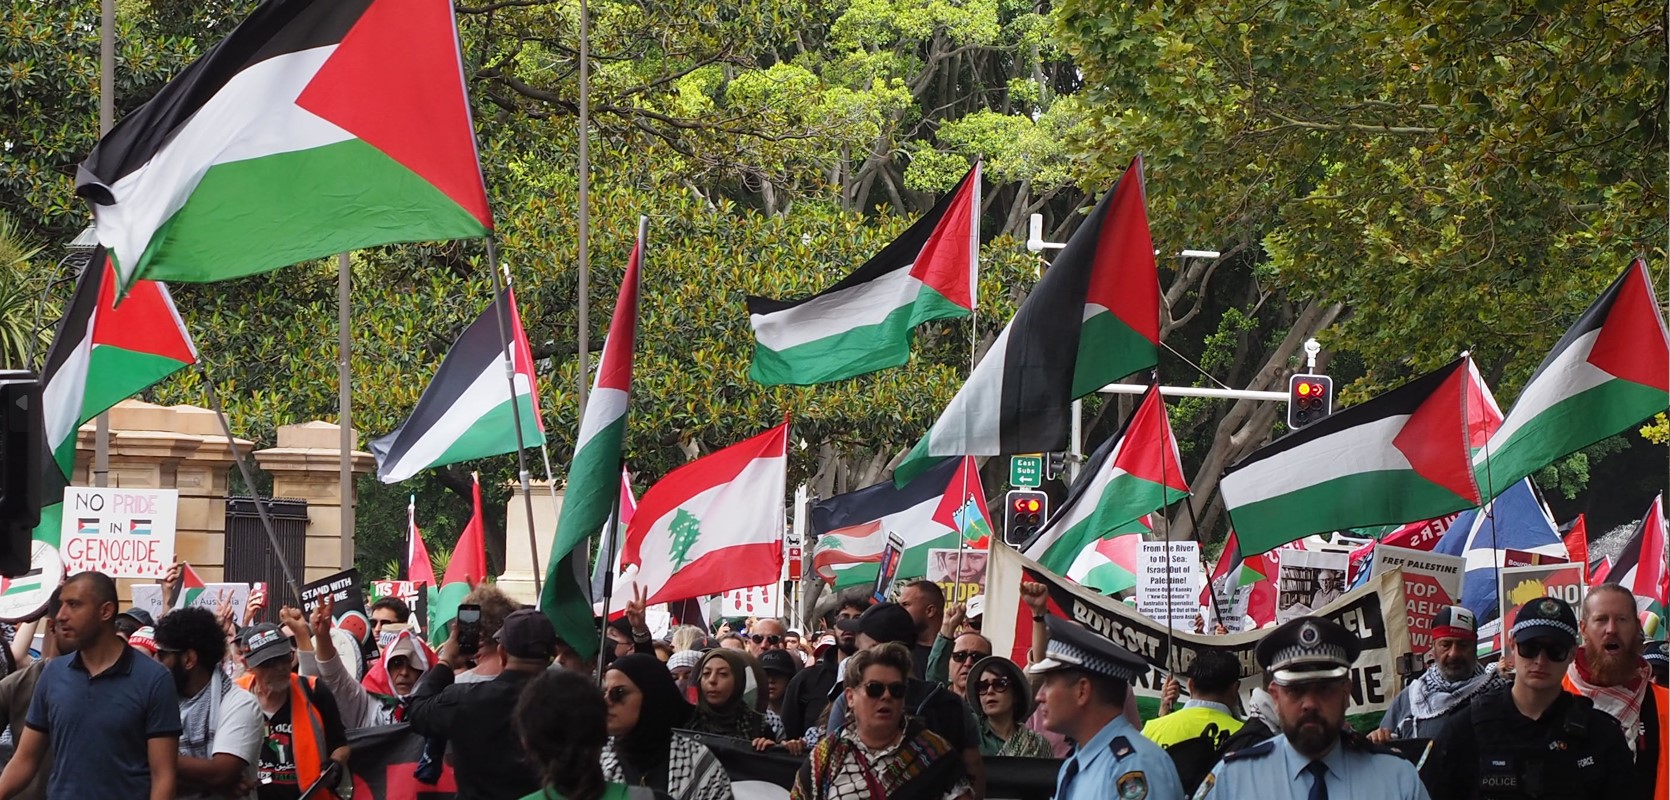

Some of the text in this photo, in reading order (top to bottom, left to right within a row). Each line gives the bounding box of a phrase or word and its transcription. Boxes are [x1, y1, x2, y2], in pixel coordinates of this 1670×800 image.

[76, 493, 158, 514] NO PRIDE
[110, 522, 122, 534] IN
[67, 538, 160, 563] GENOCIDE
[1382, 557, 1458, 574] FREE PALESTINE
[301, 577, 352, 601] STAND WITH
[397, 581, 419, 597] ALL
[1405, 581, 1438, 598] TOP
[1548, 584, 1579, 604] NO
[304, 591, 348, 612] PALSINE
[1073, 599, 1160, 660] BOYCOTT
[1577, 756, 1594, 768] FORCE
[1482, 778, 1516, 786] POLICE
